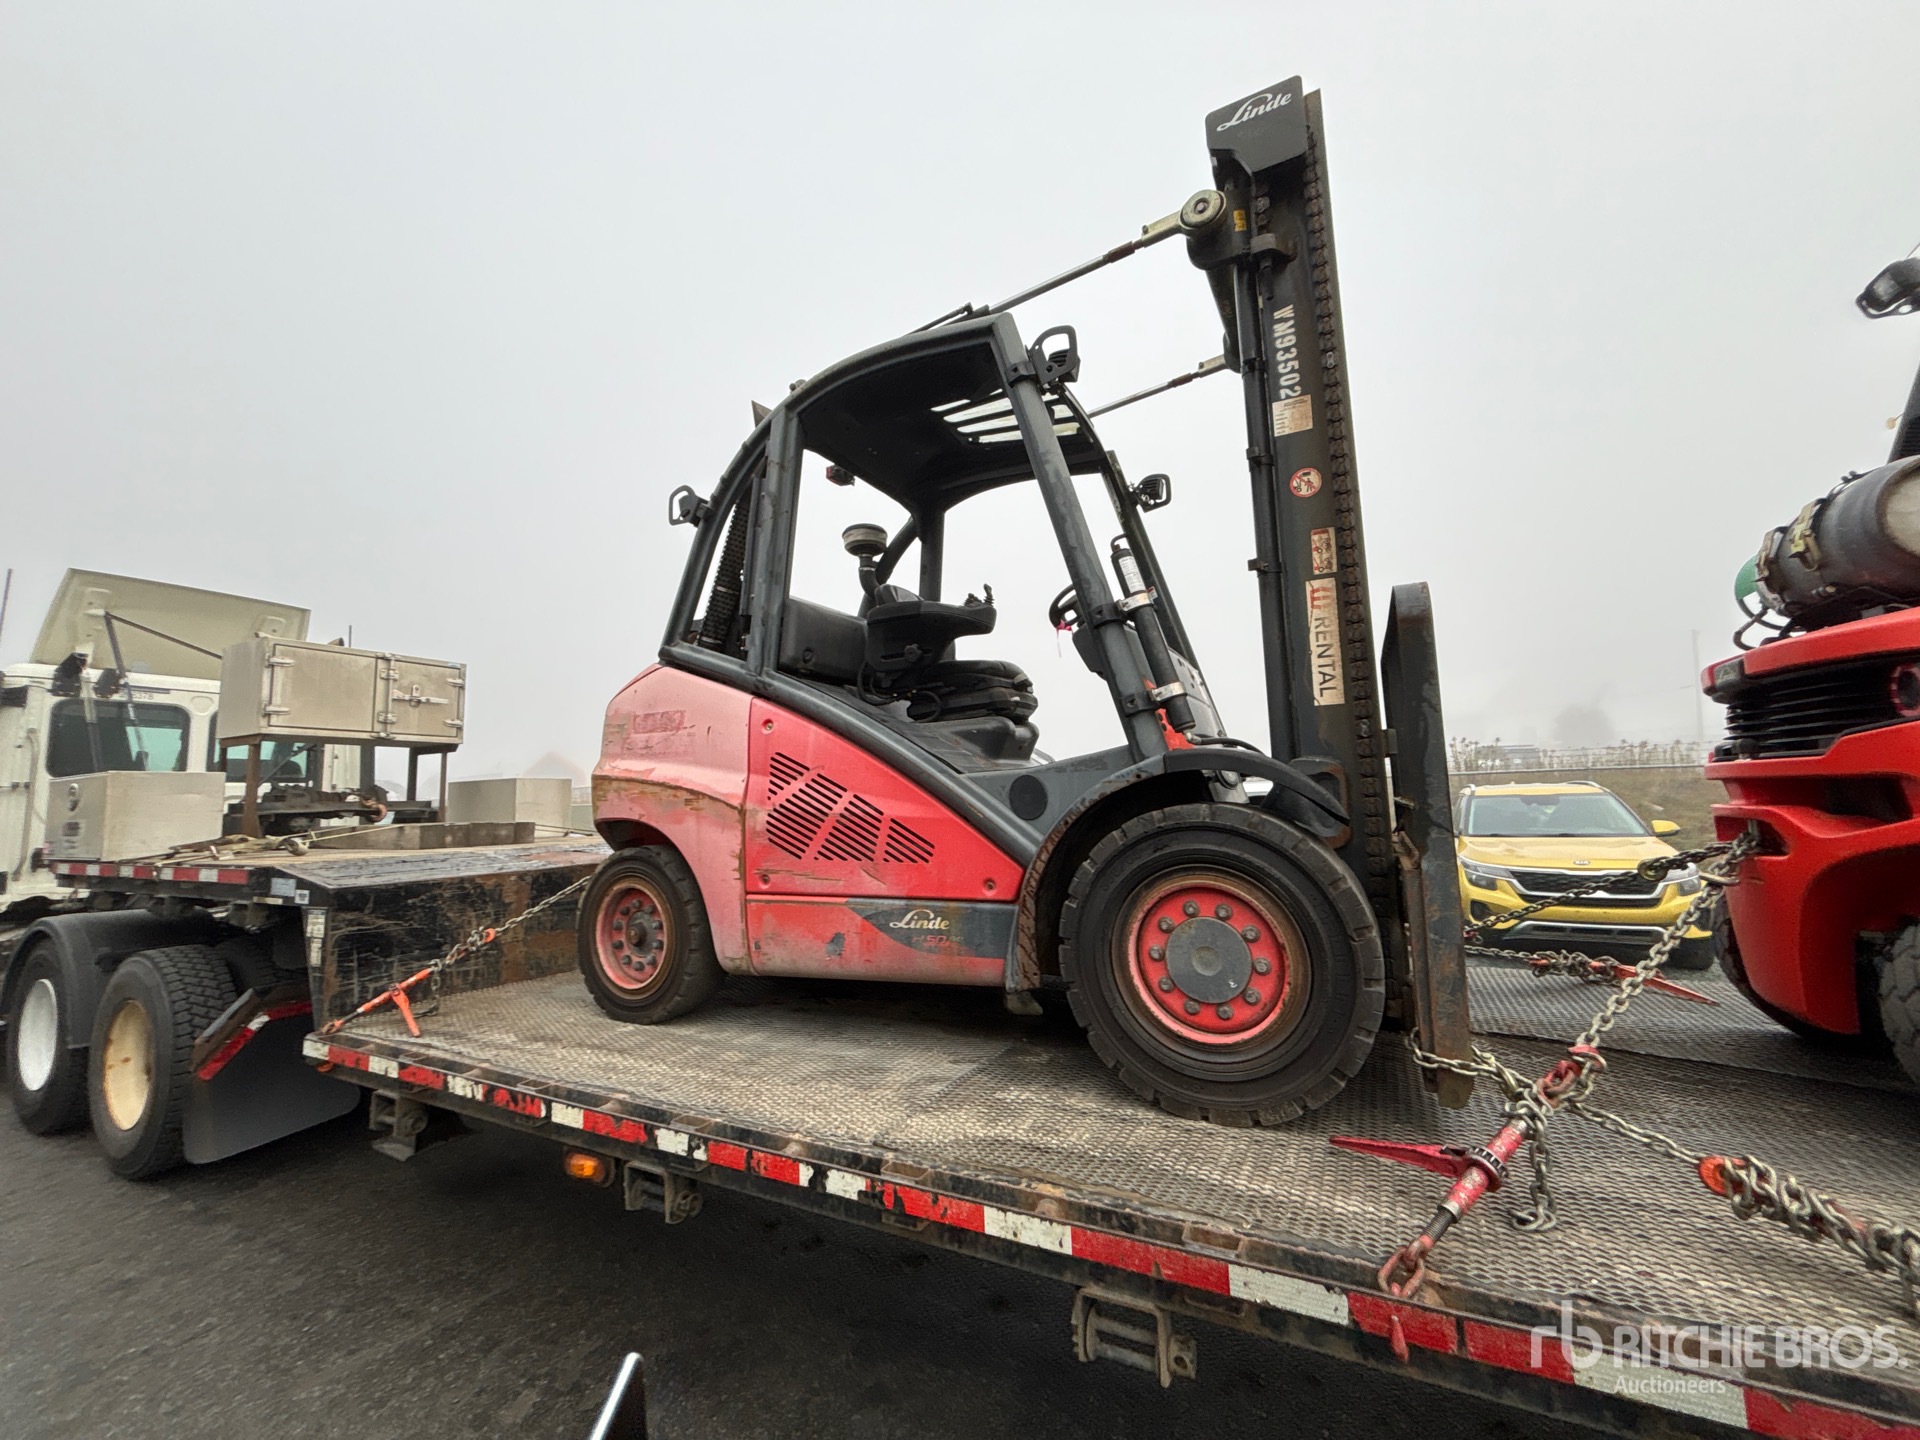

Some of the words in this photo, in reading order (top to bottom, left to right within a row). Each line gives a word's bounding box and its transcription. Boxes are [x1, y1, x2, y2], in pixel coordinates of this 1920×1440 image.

[1216, 92, 1292, 132] Linde
[1272, 304, 1302, 399] WM93502
[1314, 616, 1338, 698] RENTAL
[889, 909, 950, 929] Linde
